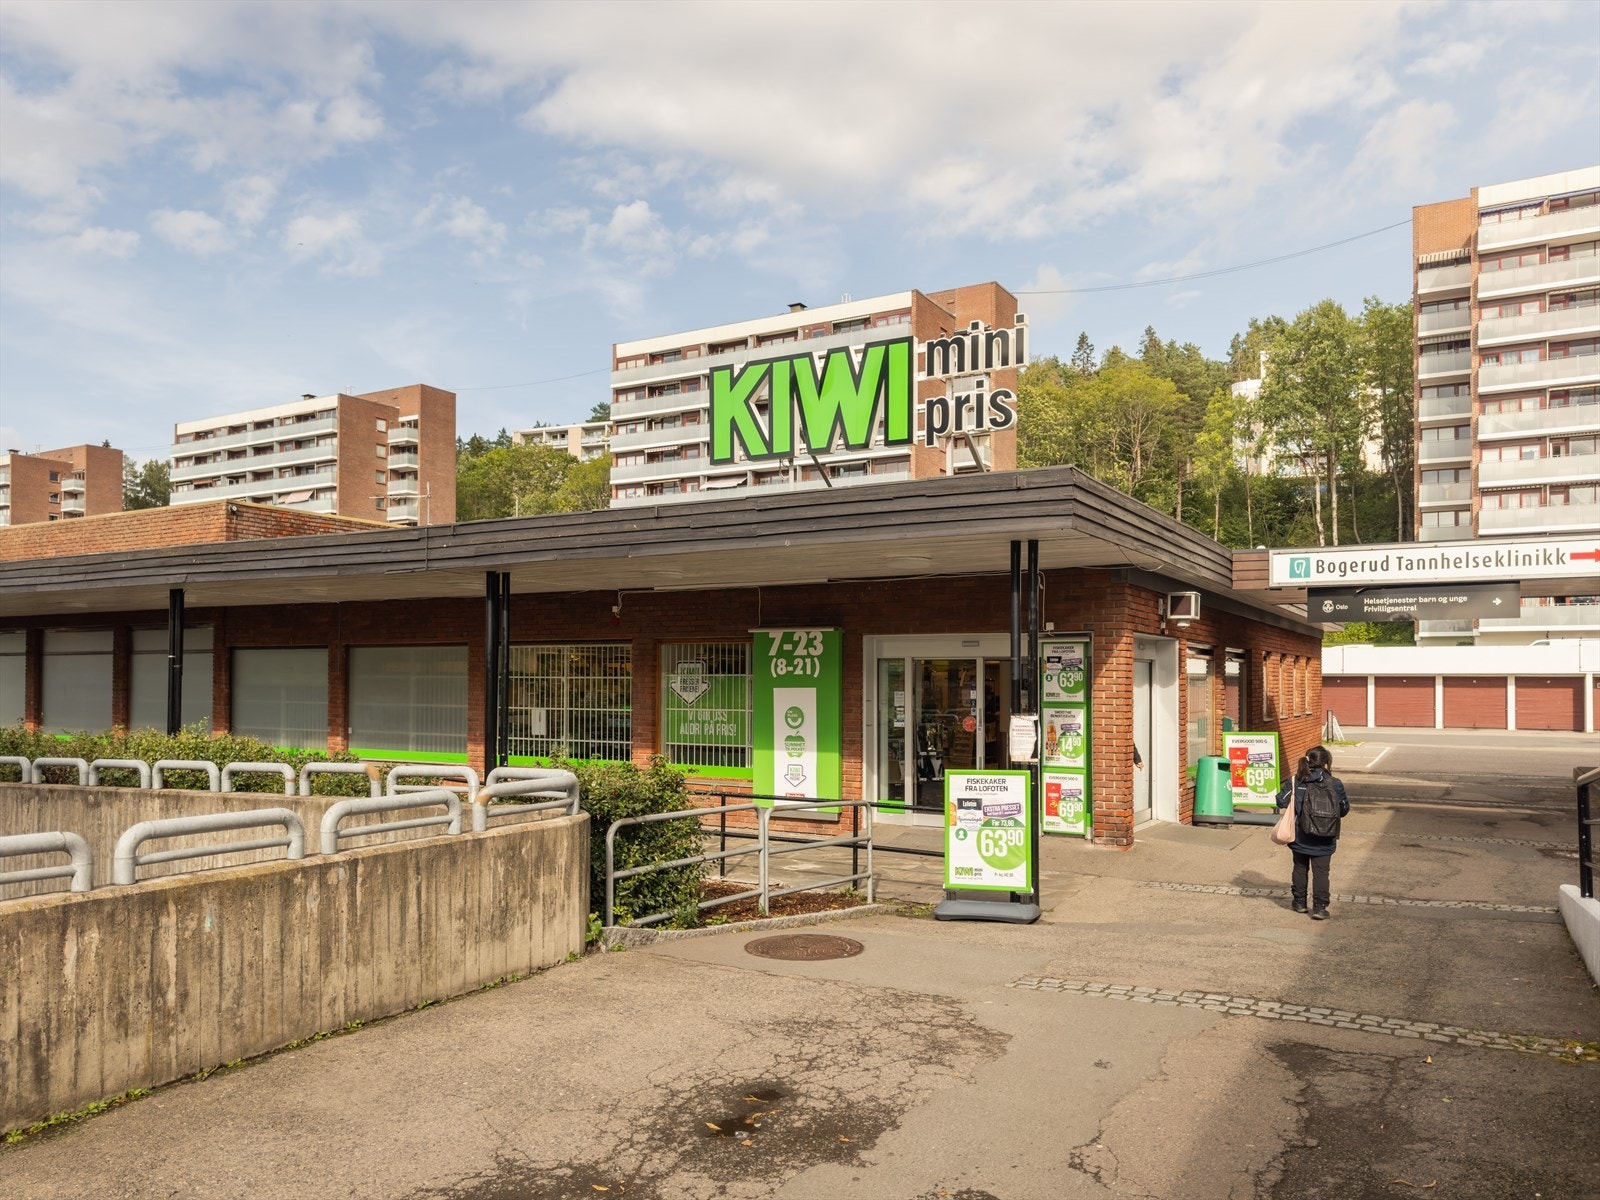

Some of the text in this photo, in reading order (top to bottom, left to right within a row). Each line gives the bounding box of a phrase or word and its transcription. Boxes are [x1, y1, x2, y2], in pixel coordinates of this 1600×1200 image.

[926, 313, 1026, 378] mini
[710, 336, 914, 465] KIWI
[926, 379, 1015, 447] pris
[1316, 547, 1567, 577] Bogerud Tannhelseklinikk
[1363, 597, 1417, 606] Helsetjenester
[1363, 604, 1417, 613] Frivilligsentral
[768, 630, 824, 656] 7-23
[770, 658, 820, 678] (8-21)
